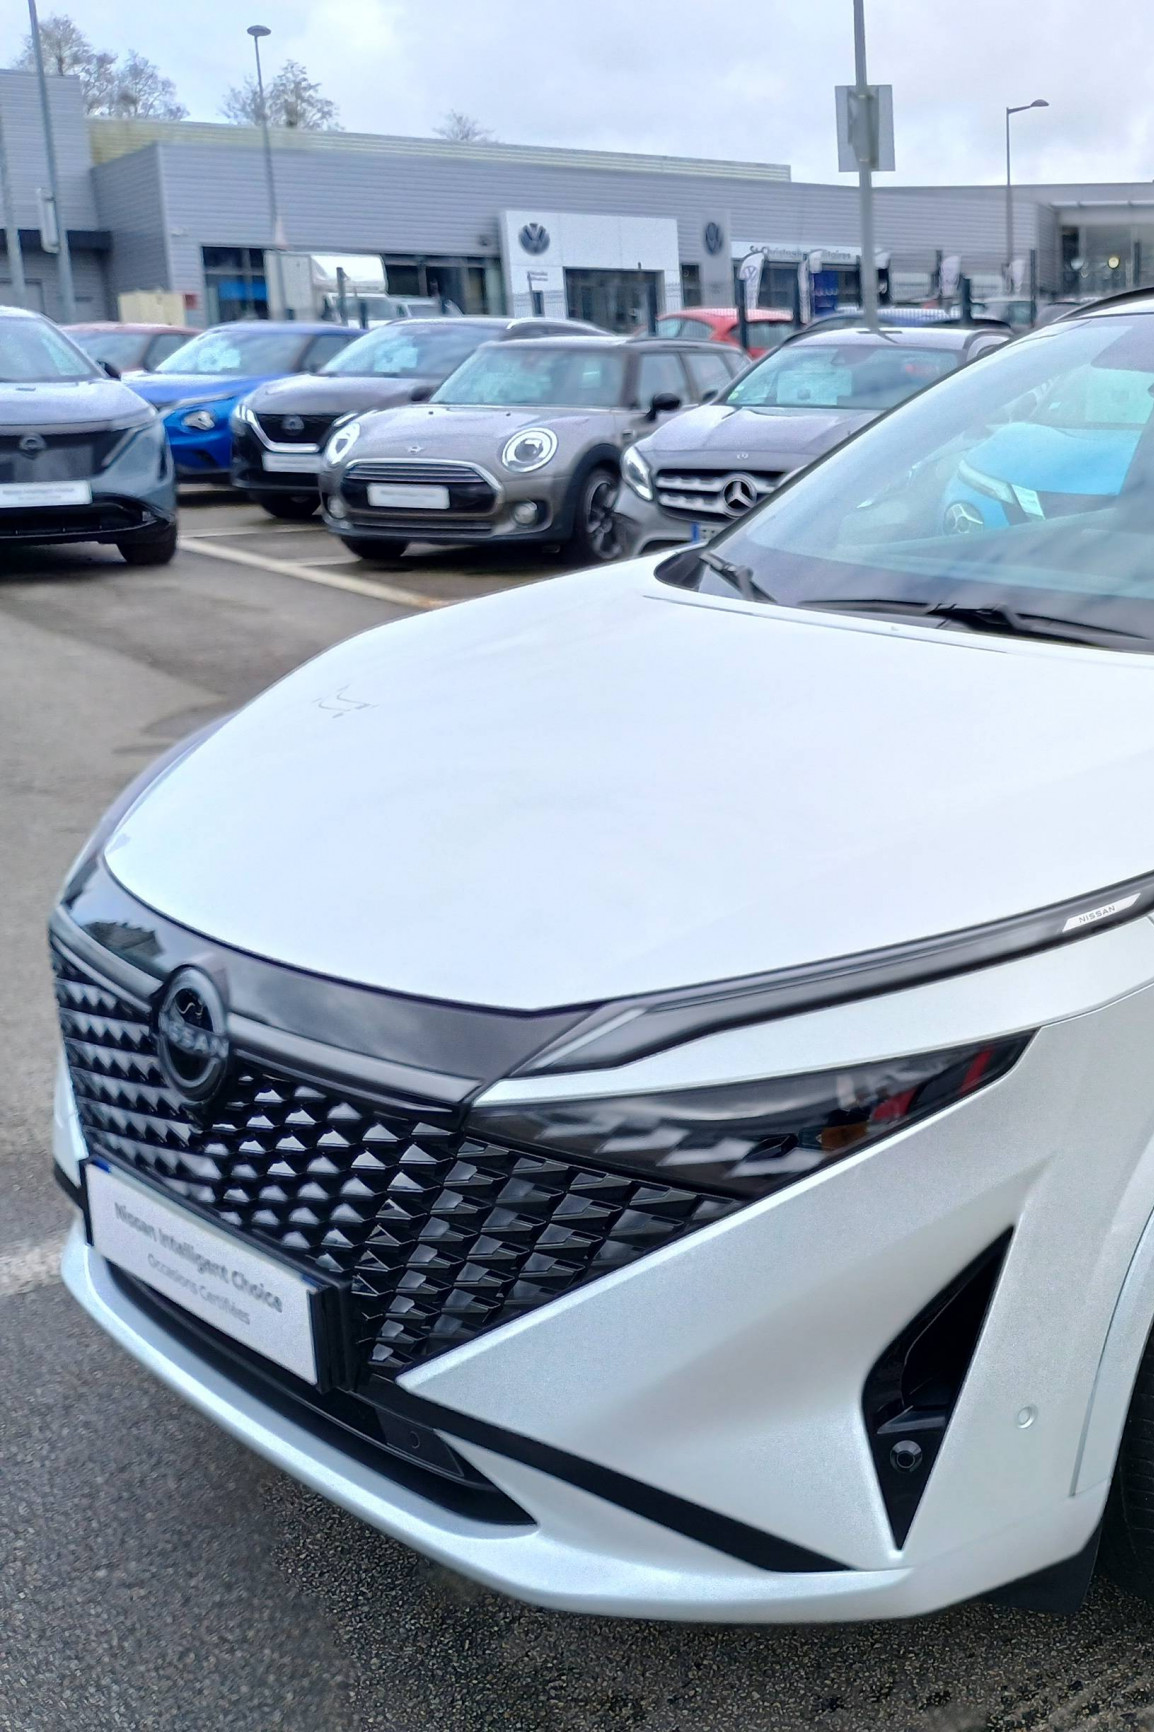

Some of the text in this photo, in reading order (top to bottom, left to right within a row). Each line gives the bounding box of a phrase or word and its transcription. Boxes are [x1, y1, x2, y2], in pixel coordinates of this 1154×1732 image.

[1078, 904, 1116, 923] NISSAN
[114, 1202, 283, 1313] Nissan Intelligent Choice
